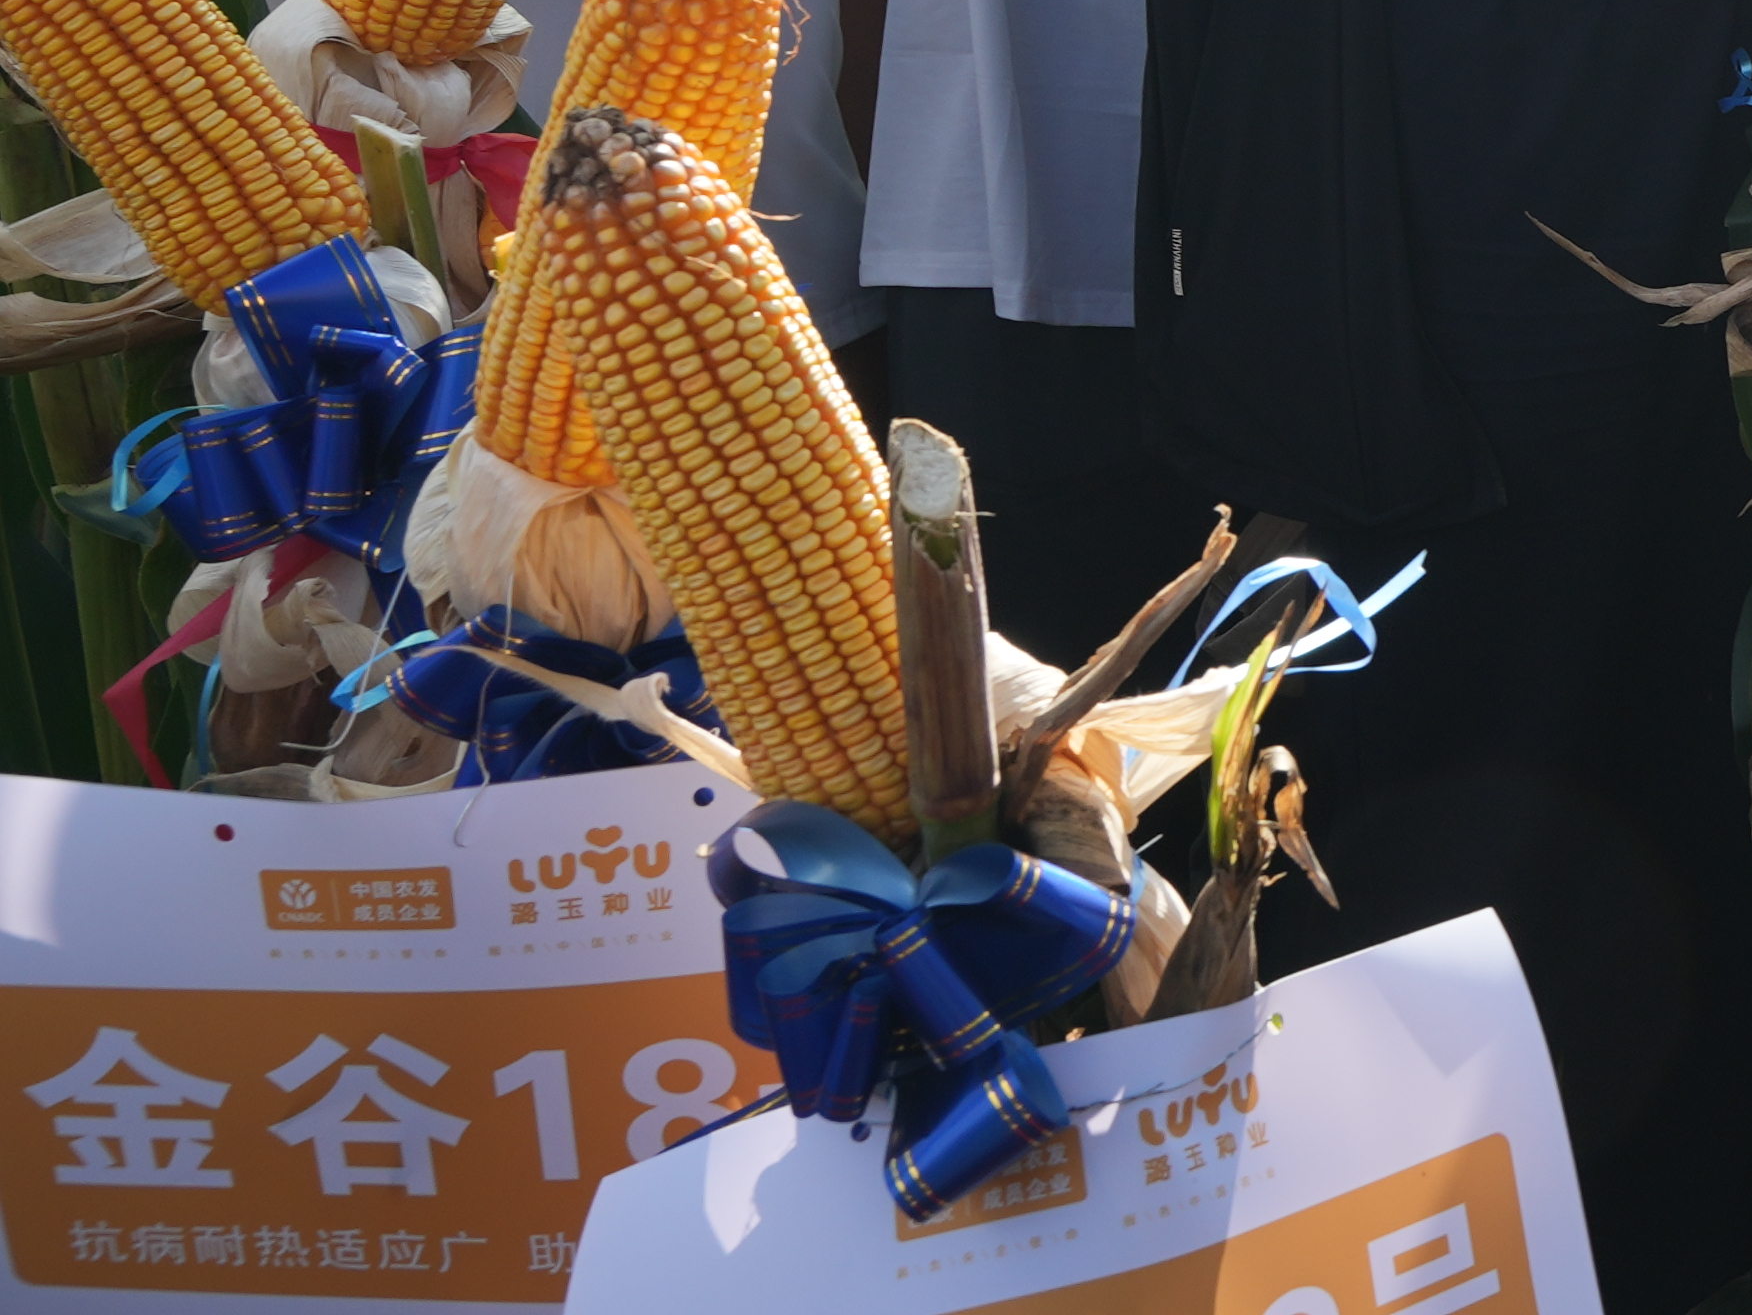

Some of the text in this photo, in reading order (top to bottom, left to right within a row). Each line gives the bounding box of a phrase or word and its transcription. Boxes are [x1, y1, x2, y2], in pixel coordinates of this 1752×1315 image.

[508, 825, 672, 893] LUYU
[349, 880, 439, 900] 中国农发
[353, 904, 441, 922] 成员企业
[510, 886, 674, 926] 潞玉种业
[1138, 1063, 1259, 1147] LUYU
[1143, 1121, 1269, 1186] 潞玉种业
[982, 1172, 1072, 1212] 成员企业
[68, 1221, 487, 1275] 抗病耐热适应广
